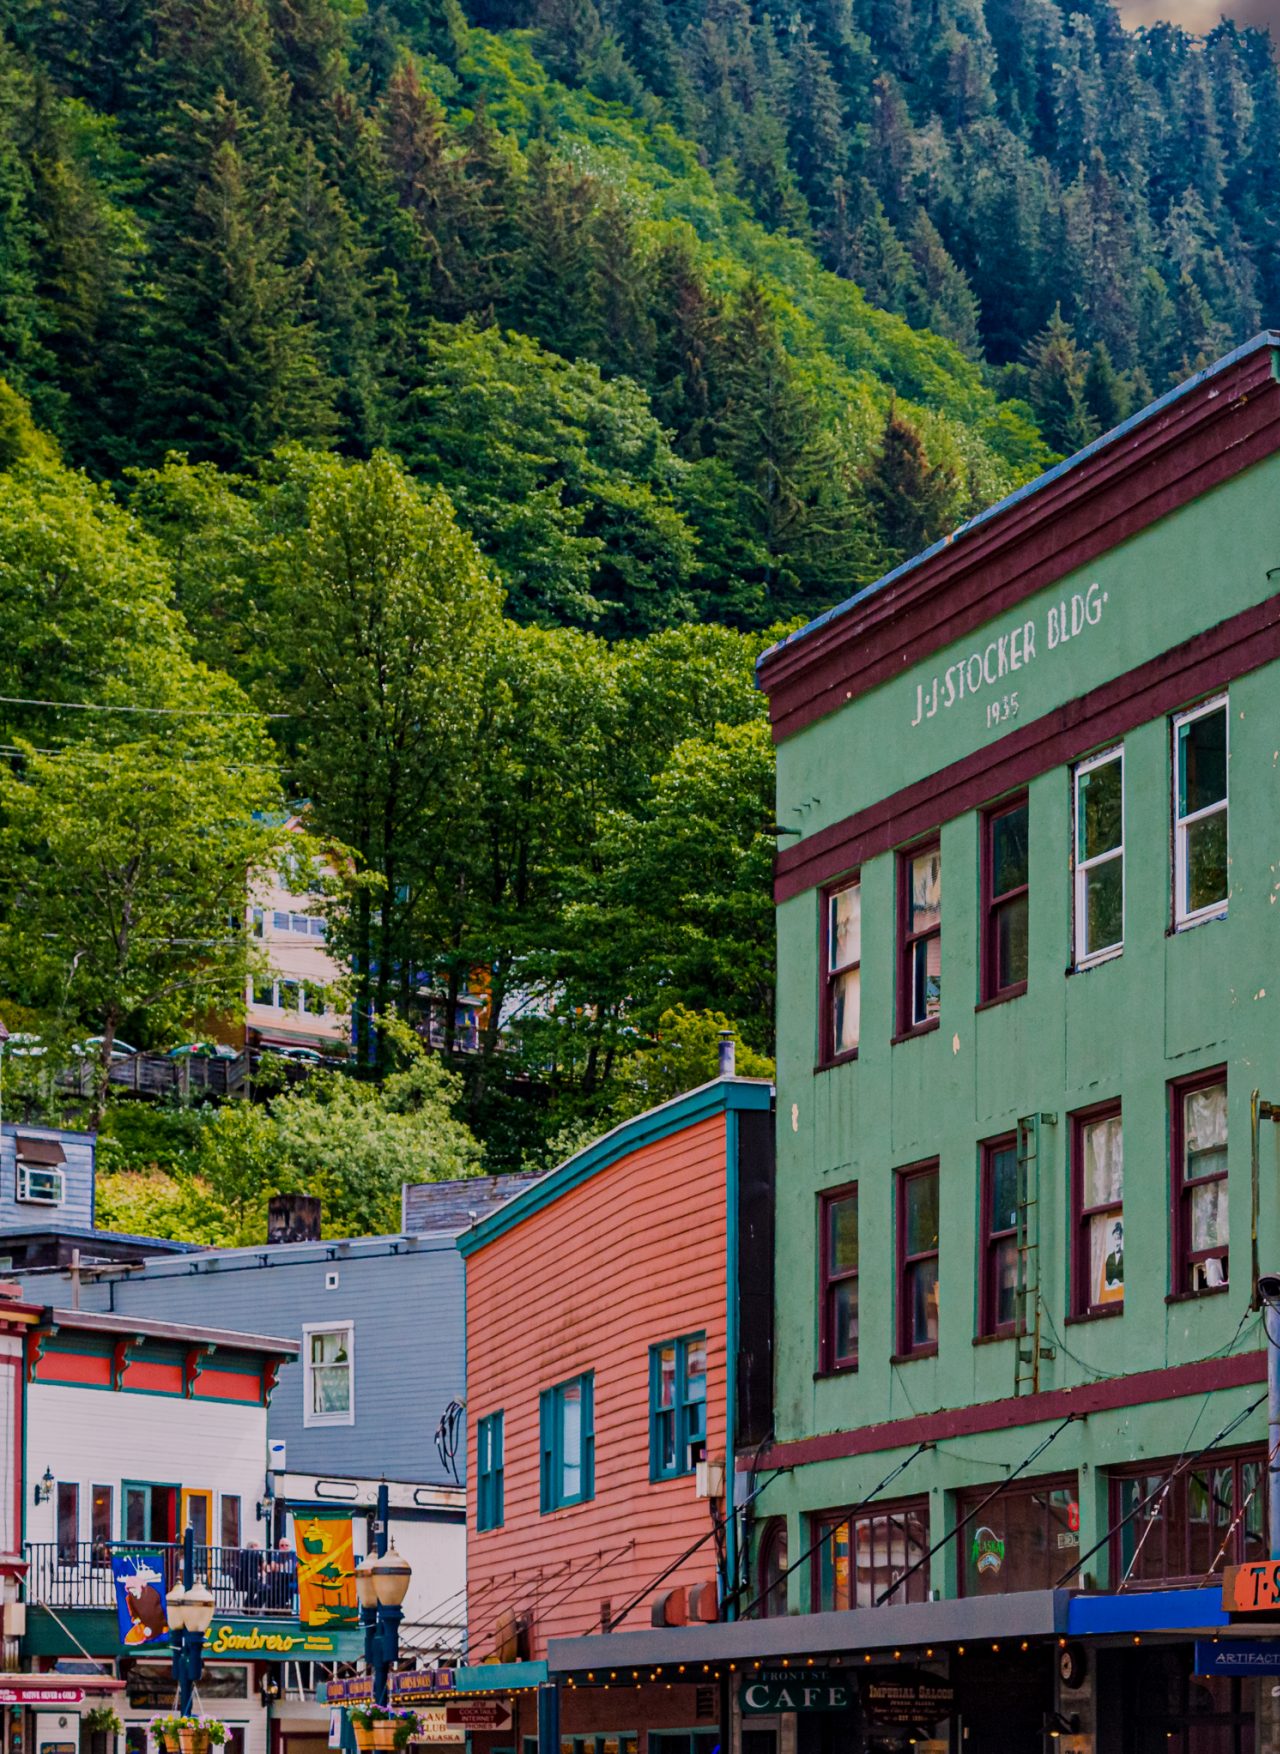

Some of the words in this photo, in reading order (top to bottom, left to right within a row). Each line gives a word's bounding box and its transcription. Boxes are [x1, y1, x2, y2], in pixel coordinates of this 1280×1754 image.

[986, 691, 1019, 728] 1935
[212, 1625, 305, 1653] Sombrero
[763, 1671, 805, 1681] FRONT
[745, 1684, 847, 1709] CAFE
[868, 1683, 916, 1699] IMPERIAL
